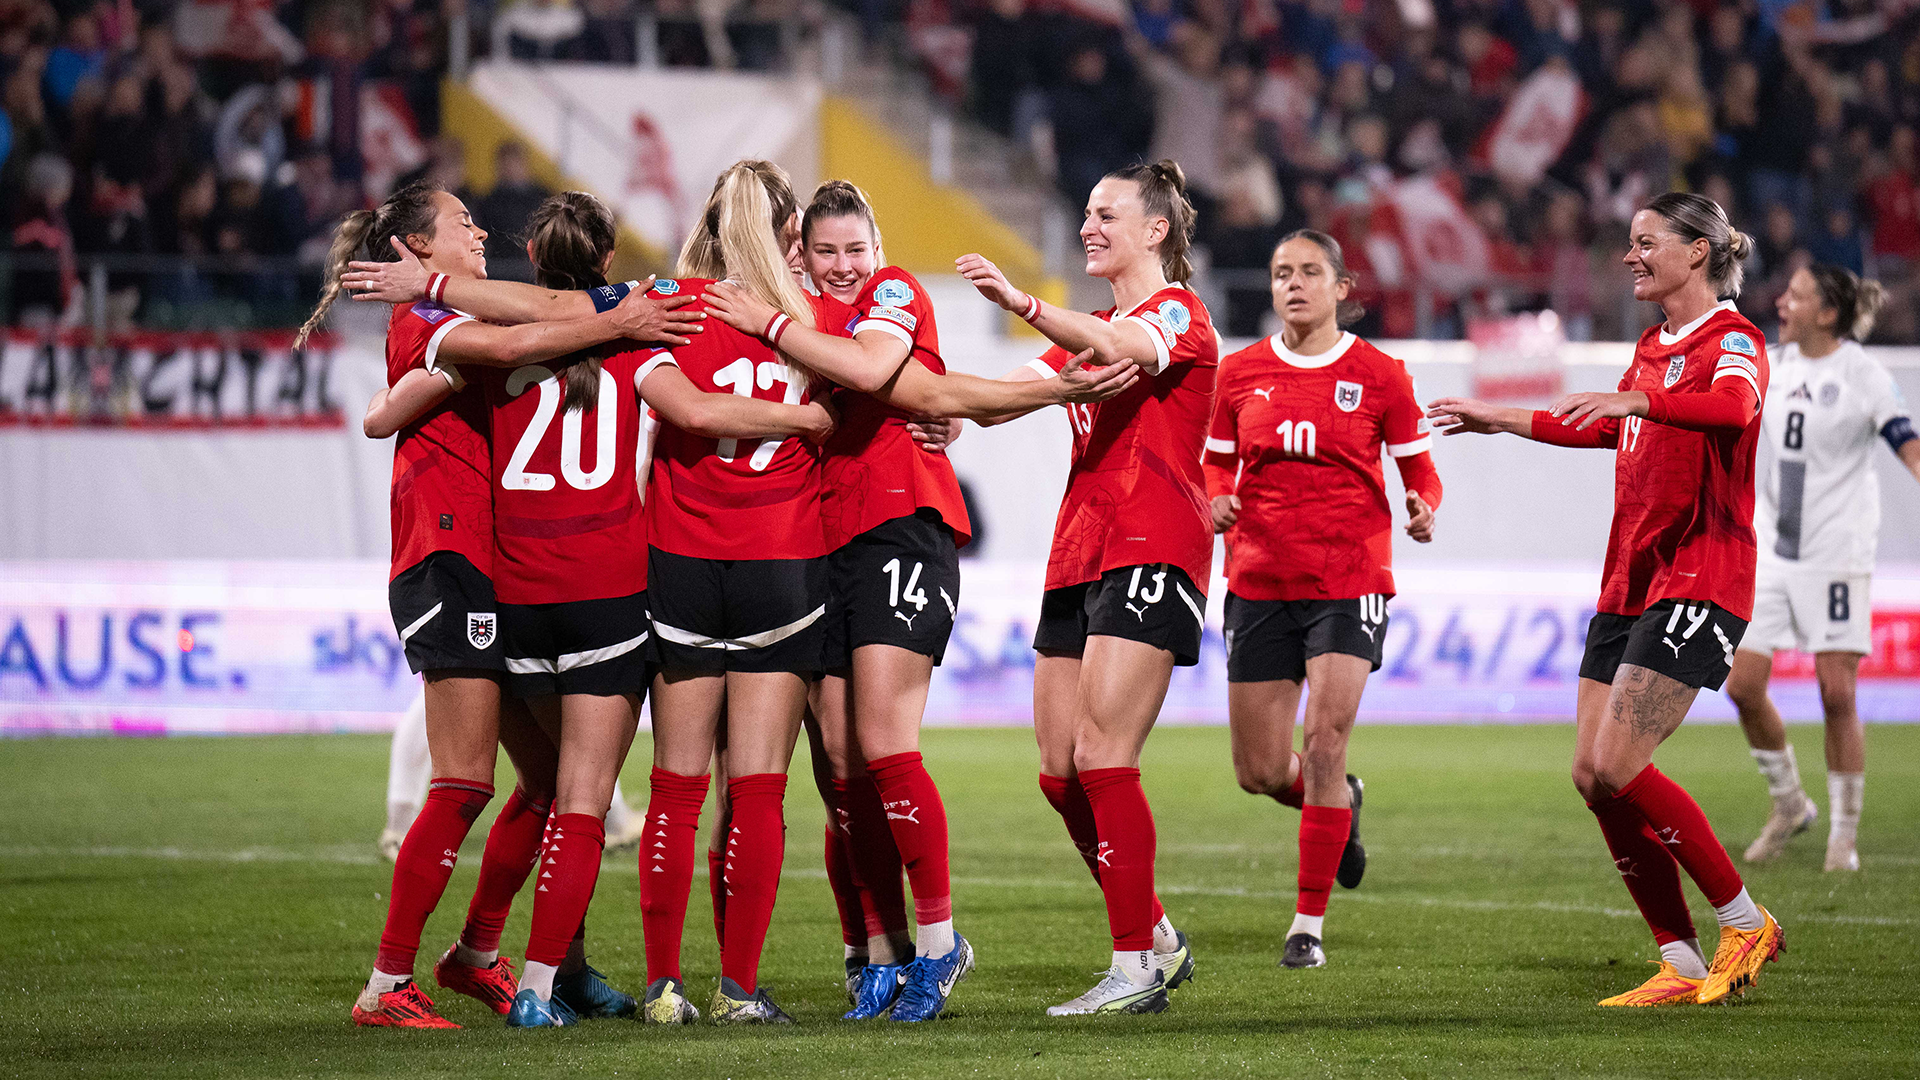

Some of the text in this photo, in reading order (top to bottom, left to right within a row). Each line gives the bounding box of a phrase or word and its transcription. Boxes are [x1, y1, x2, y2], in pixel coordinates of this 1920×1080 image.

[501, 365, 617, 491] 20
[713, 357, 808, 471] 17
[1070, 402, 1091, 435] 13
[1622, 414, 1642, 452] 19
[1784, 411, 1804, 450] 8
[1276, 420, 1316, 458] 10
[882, 558, 928, 611] 14
[1127, 563, 1168, 604] 13
[1828, 582, 1850, 622] 8
[1360, 593, 1384, 625] 10
[1665, 597, 1711, 640] 19
[1140, 949, 1149, 970] IGN
